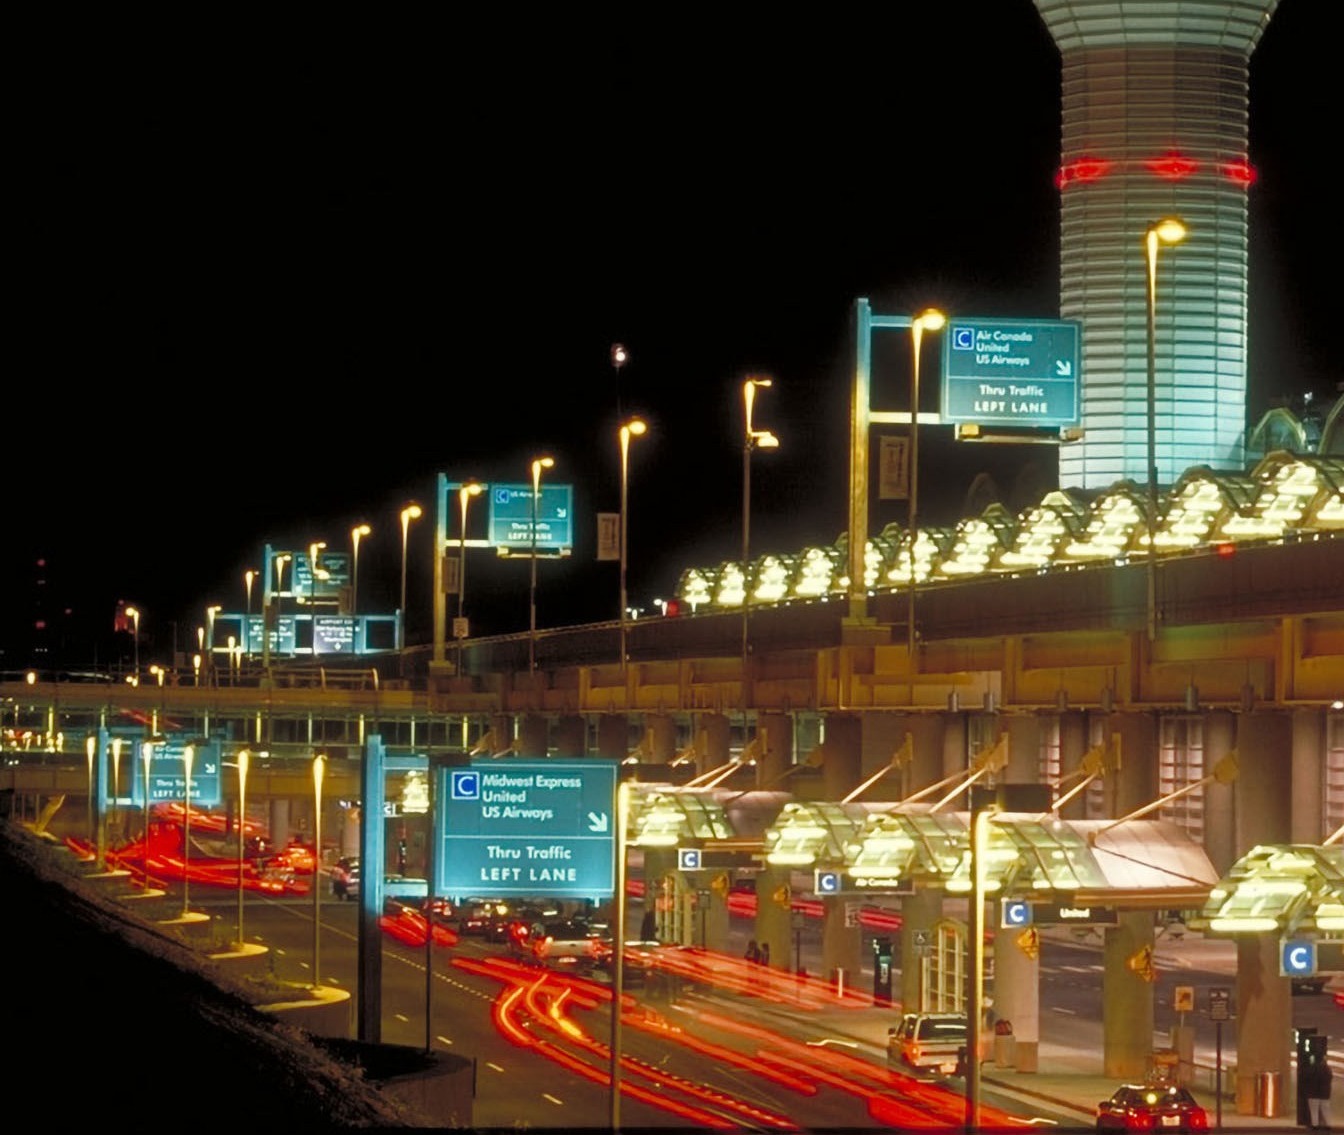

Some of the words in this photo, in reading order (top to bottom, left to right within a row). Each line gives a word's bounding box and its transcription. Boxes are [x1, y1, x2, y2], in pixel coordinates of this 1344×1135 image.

[957, 331, 971, 347] C
[976, 330, 992, 341] Air
[993, 331, 1033, 342] Canada
[976, 342, 1009, 353] United
[976, 354, 990, 365] US
[991, 355, 1030, 367] Airways
[979, 384, 1006, 396] Thru
[1009, 385, 1044, 396] Traffic
[974, 401, 1006, 412] LEFT
[1011, 402, 1048, 413] LANE
[458, 776, 474, 796] C
[482, 775, 533, 788] Midwest
[536, 775, 581, 790] Express
[483, 791, 526, 803] United
[482, 807, 500, 819] US
[502, 807, 553, 821] Airways
[487, 846, 521, 859] Thru
[526, 846, 572, 860] Traffic
[684, 852, 696, 867] C
[481, 868, 521, 881] LEFT
[529, 869, 577, 882] LANE
[821, 874, 834, 891] C
[1010, 904, 1024, 923] C
[1290, 947, 1307, 970] C
